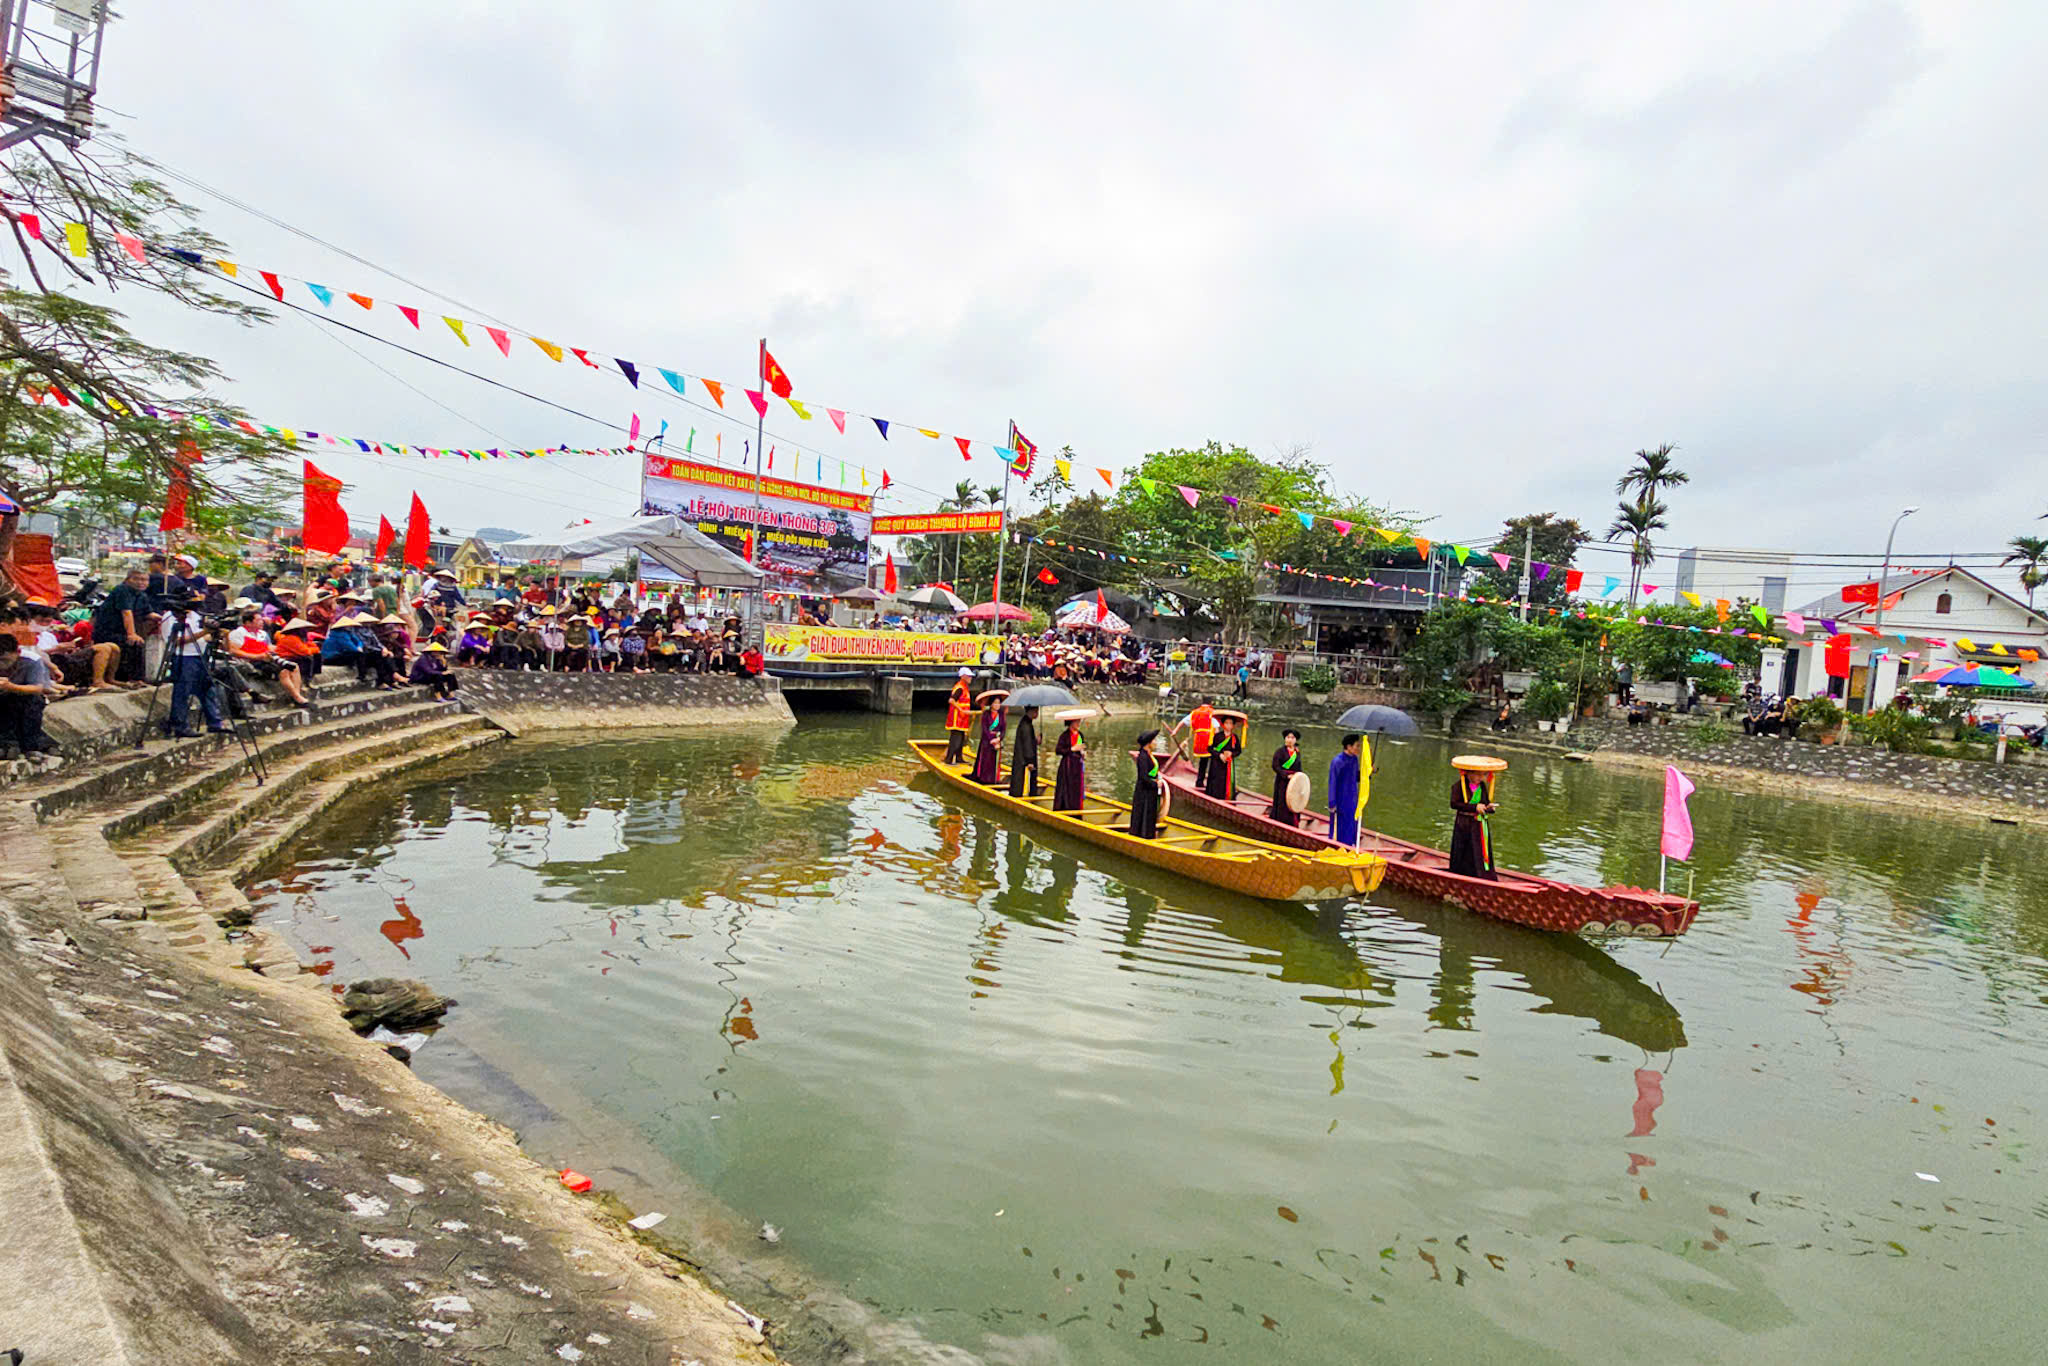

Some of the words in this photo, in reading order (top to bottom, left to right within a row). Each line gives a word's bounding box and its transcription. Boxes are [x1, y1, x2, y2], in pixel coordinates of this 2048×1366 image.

[690, 495, 705, 515] LỄ
[708, 500, 729, 519] HỘI
[733, 504, 778, 526] TRUYỀN
[782, 511, 818, 532] THỐNG
[819, 520, 837, 536] 3/3
[988, 515, 1001, 528] AN
[698, 521, 718, 534] ĐÌNH
[850, 632, 882, 655] THUYỀN
[913, 639, 934, 657] QUAN
[967, 642, 976, 658] CO
